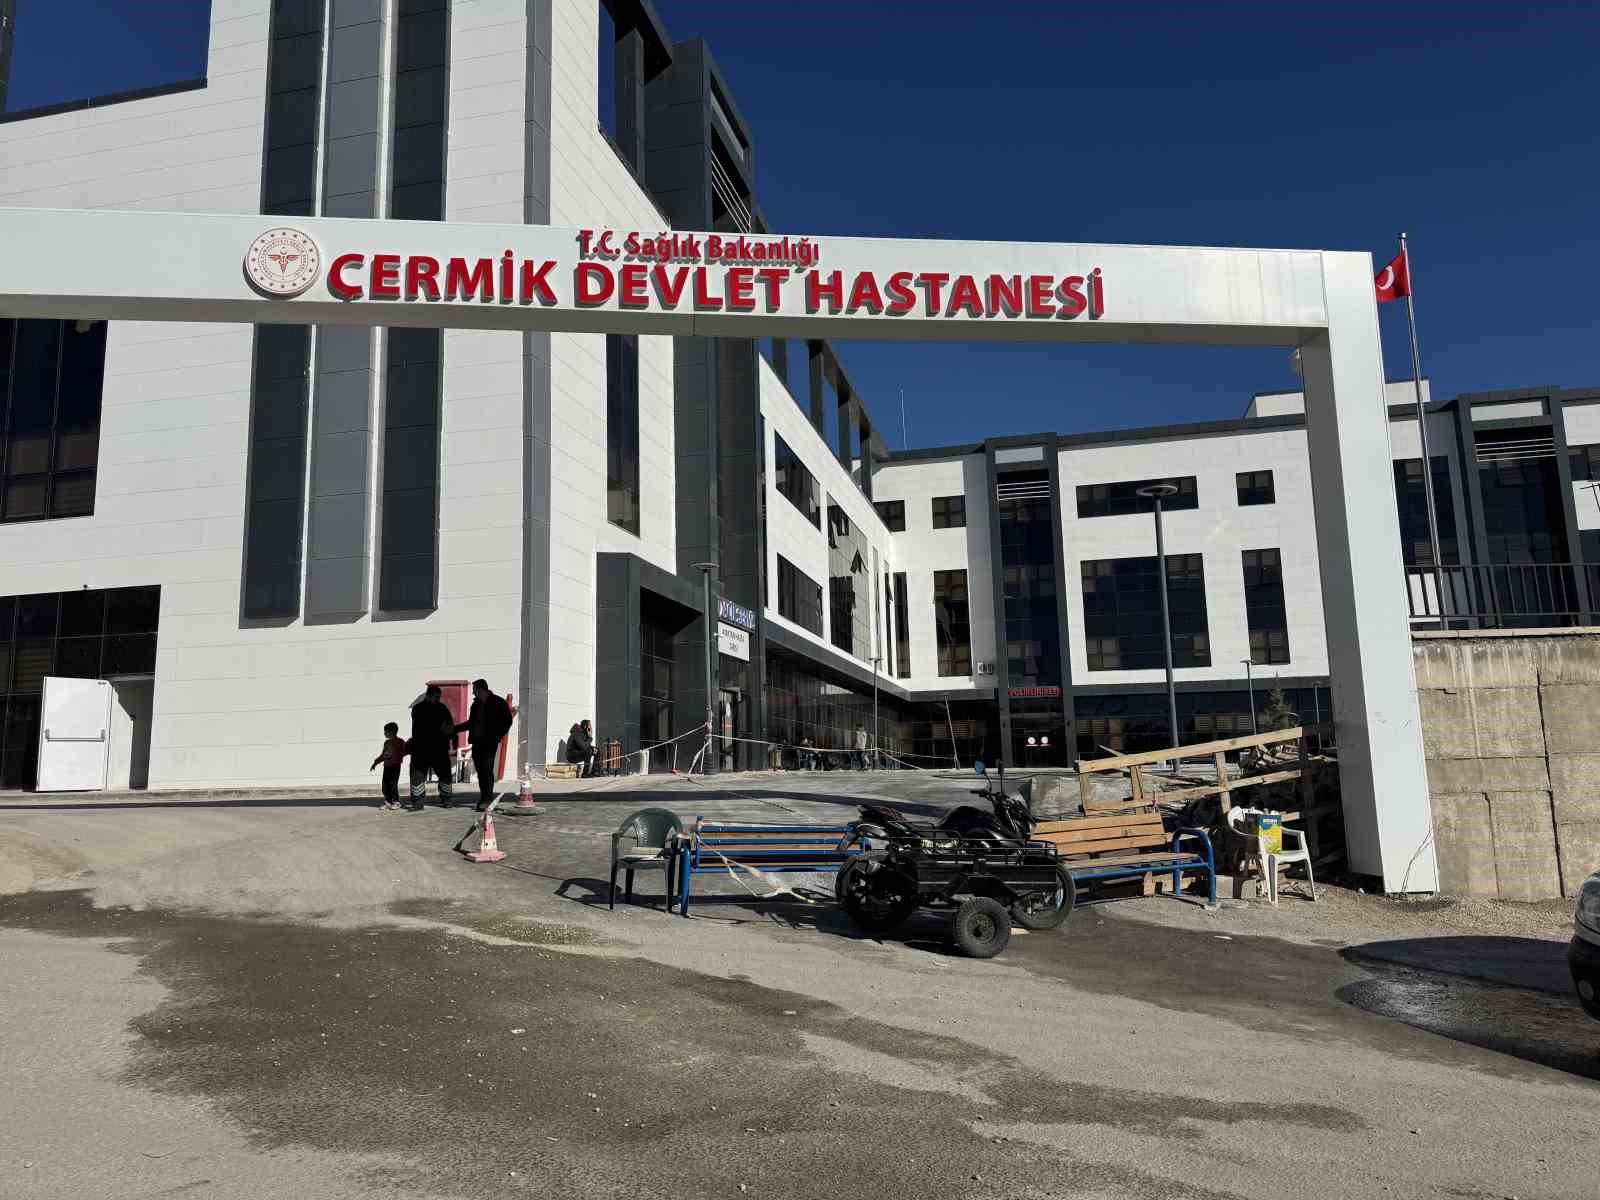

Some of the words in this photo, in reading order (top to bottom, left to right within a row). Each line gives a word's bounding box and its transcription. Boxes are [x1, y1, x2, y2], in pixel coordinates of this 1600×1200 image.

[578, 228, 621, 255] T.C.
[627, 231, 700, 263] Sağlık
[708, 234, 819, 266] Bakanlığı
[329, 250, 556, 301] ÇERMİK
[576, 261, 790, 308] DEVLET
[808, 268, 1105, 316] HASTANESİ
